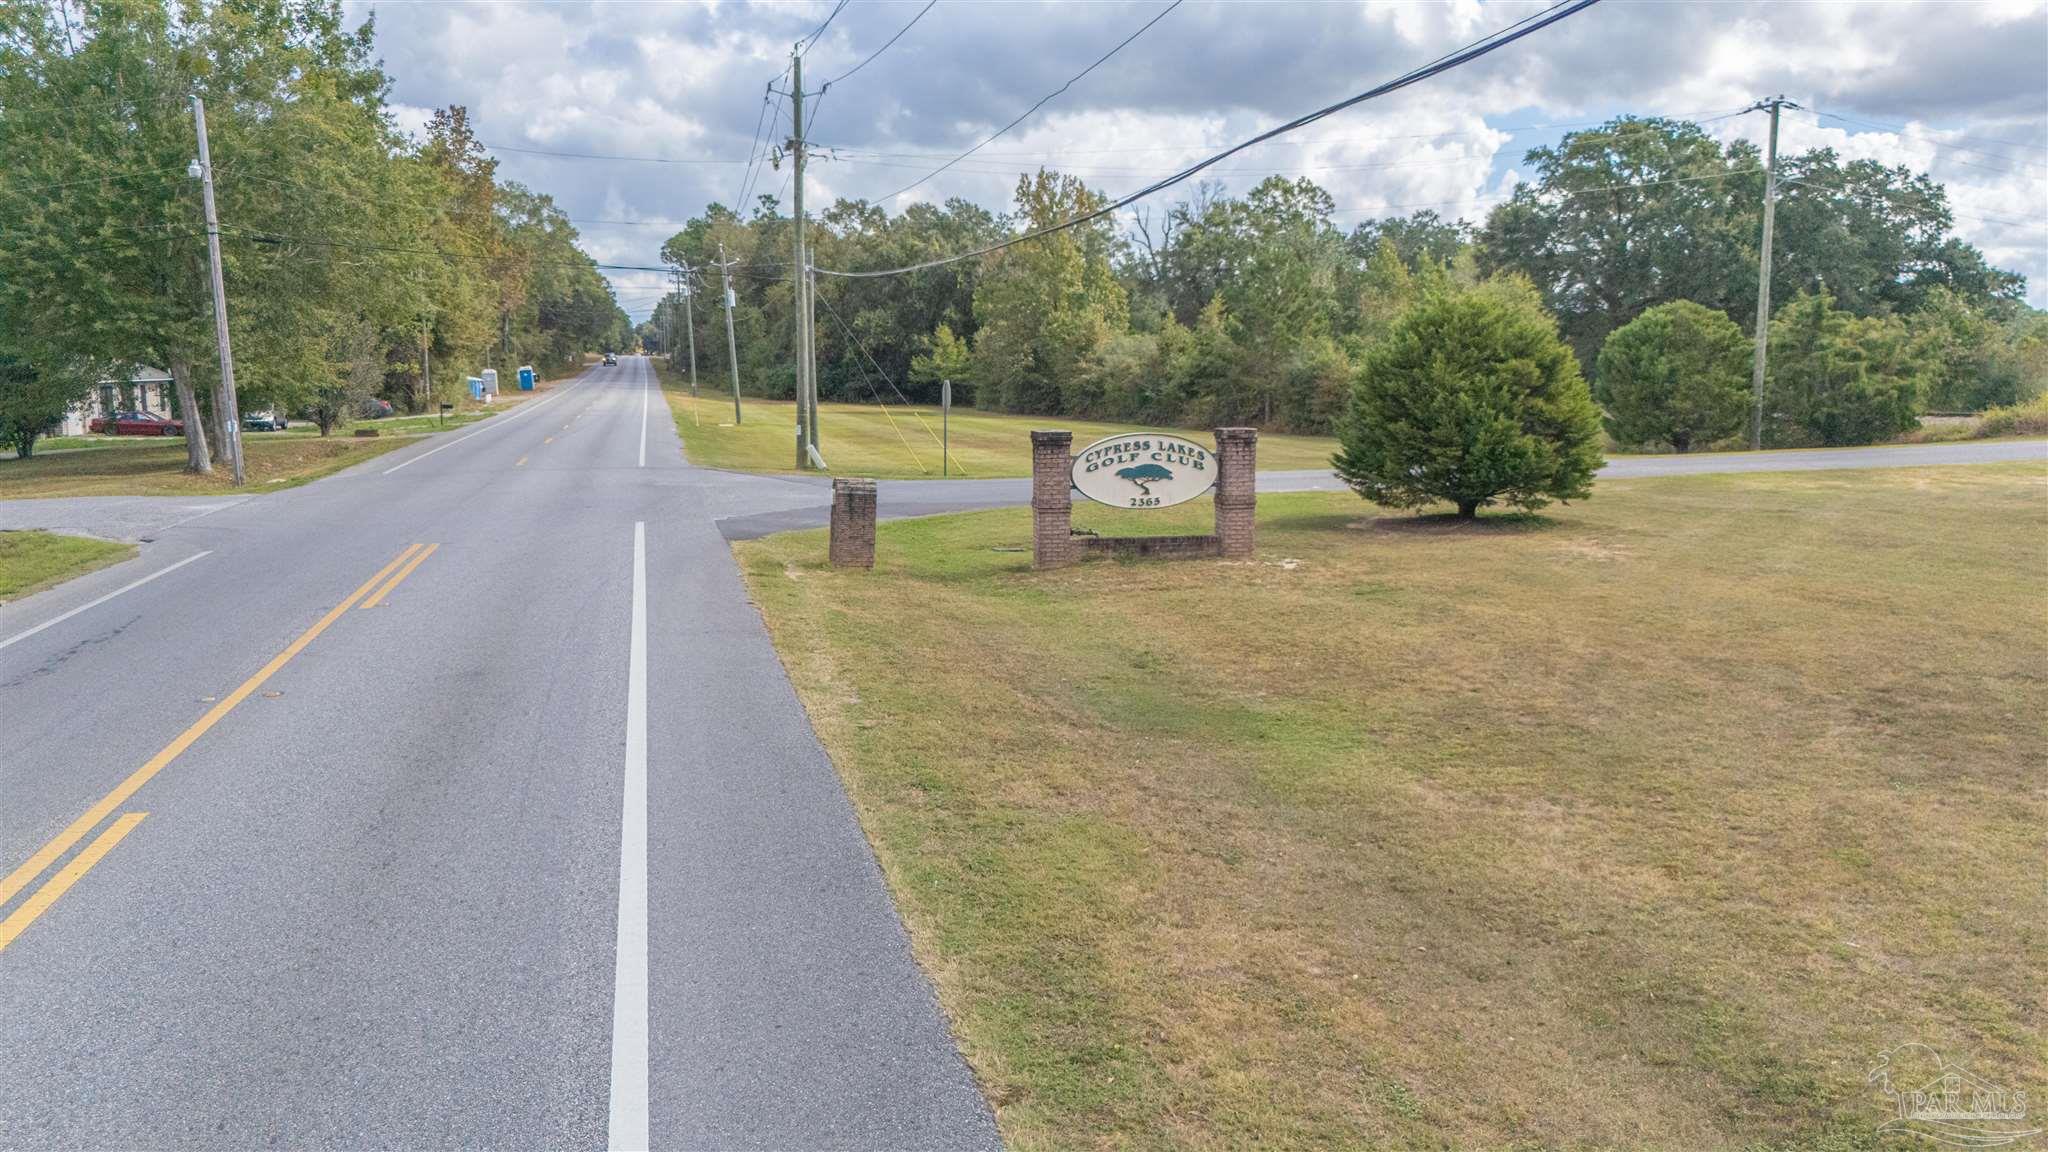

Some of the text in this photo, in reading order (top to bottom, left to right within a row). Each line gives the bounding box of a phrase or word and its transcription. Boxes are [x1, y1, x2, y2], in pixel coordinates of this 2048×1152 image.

[1085, 440, 1205, 463] CYPRESS LAKES
[1085, 452, 1205, 473] GOLF CLUB
